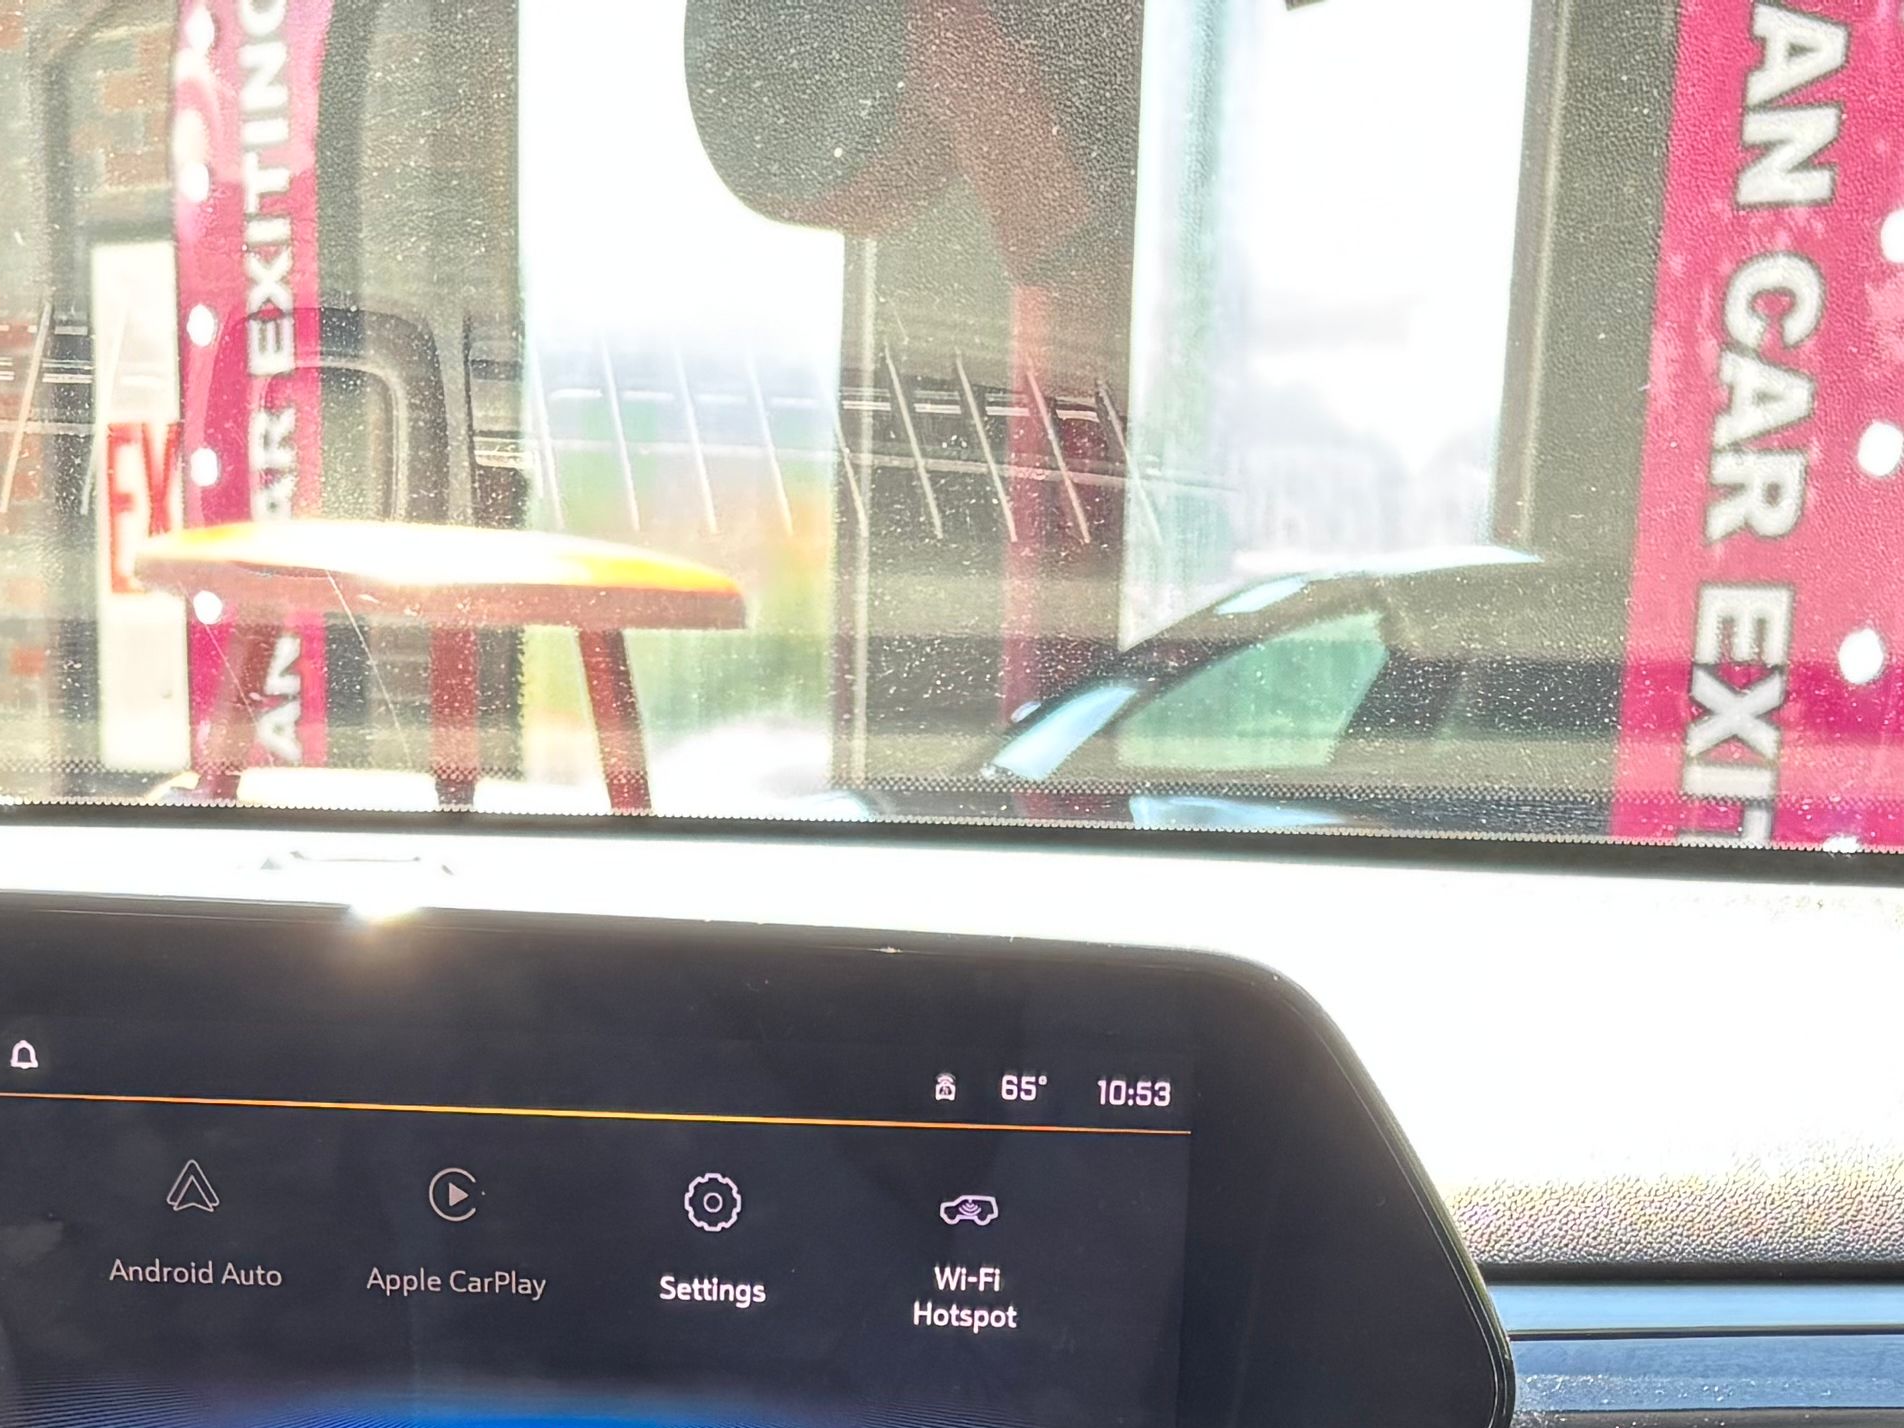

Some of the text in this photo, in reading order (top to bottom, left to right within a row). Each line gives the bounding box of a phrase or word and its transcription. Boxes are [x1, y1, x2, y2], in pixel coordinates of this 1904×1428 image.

[1705, 252, 1825, 542] CAR
[248, 407, 296, 520] AR
[1001, 1074, 1172, 1108] 65° 10:53
[109, 1259, 283, 1288] Android Auto
[366, 1266, 547, 1300] Apple CarPlay
[933, 1264, 1002, 1294] Wi-Fi
[658, 1274, 768, 1309] Settings
[912, 1301, 1018, 1335] Hotspot
